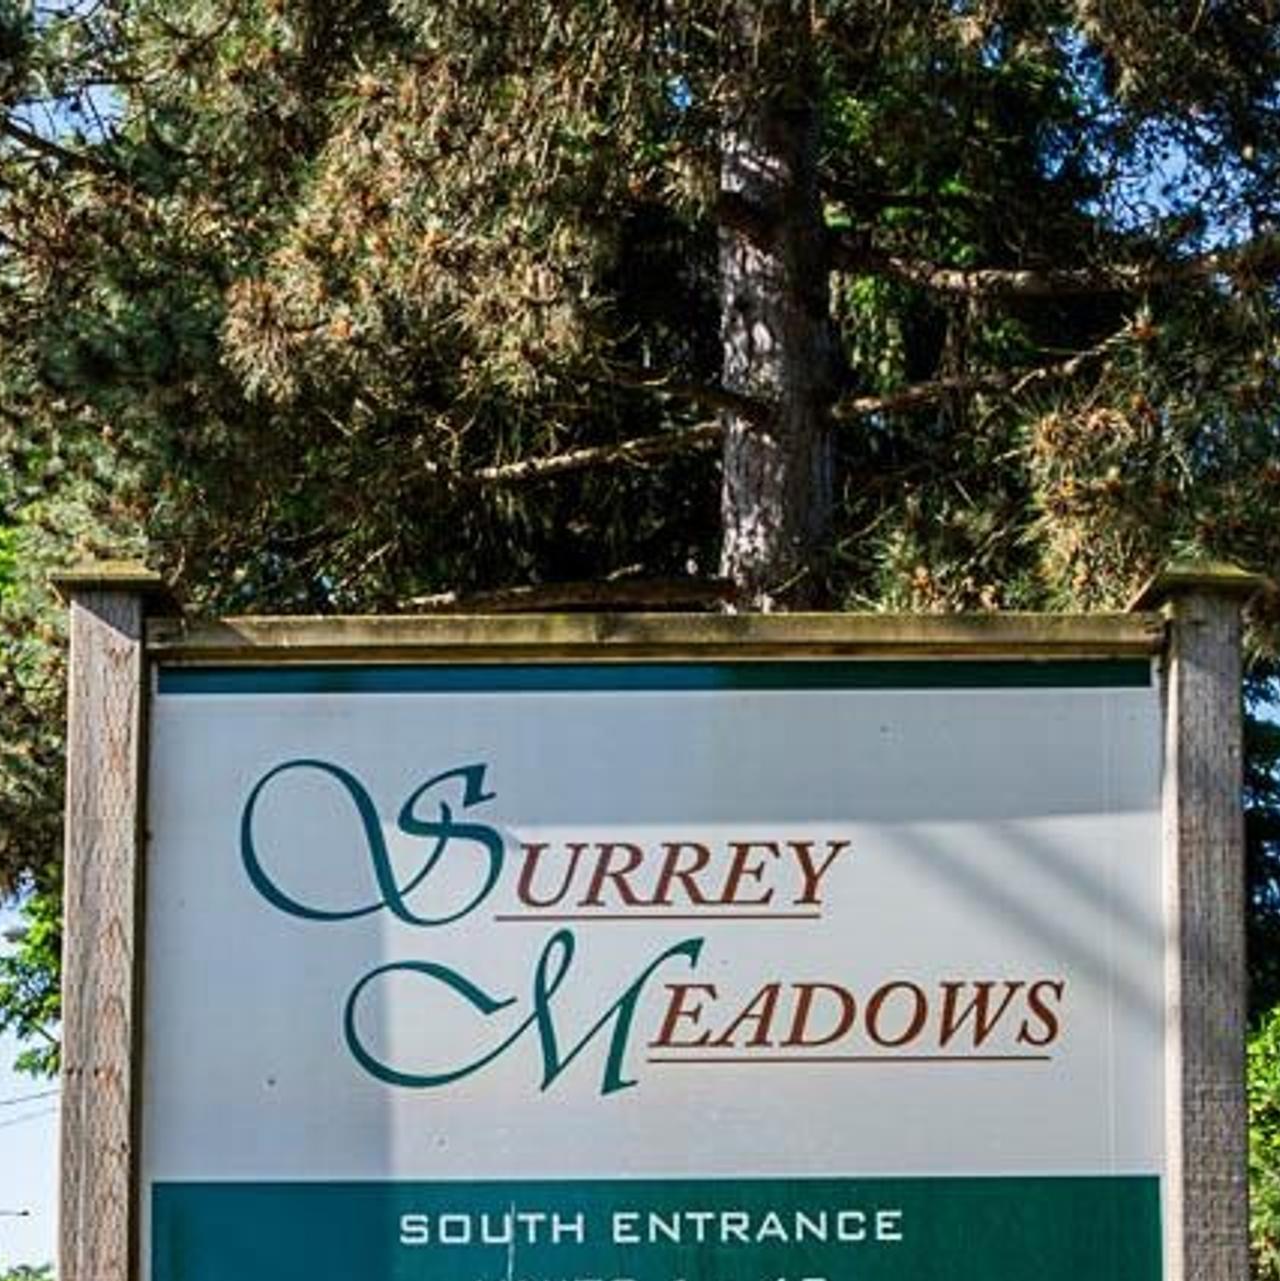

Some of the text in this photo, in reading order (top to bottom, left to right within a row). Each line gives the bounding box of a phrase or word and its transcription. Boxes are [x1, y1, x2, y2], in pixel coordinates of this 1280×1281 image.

[239, 758, 851, 927] SURREY
[343, 928, 1065, 1096] MEADOWS
[400, 1210, 903, 1245] SOUTH ENTRANCE
